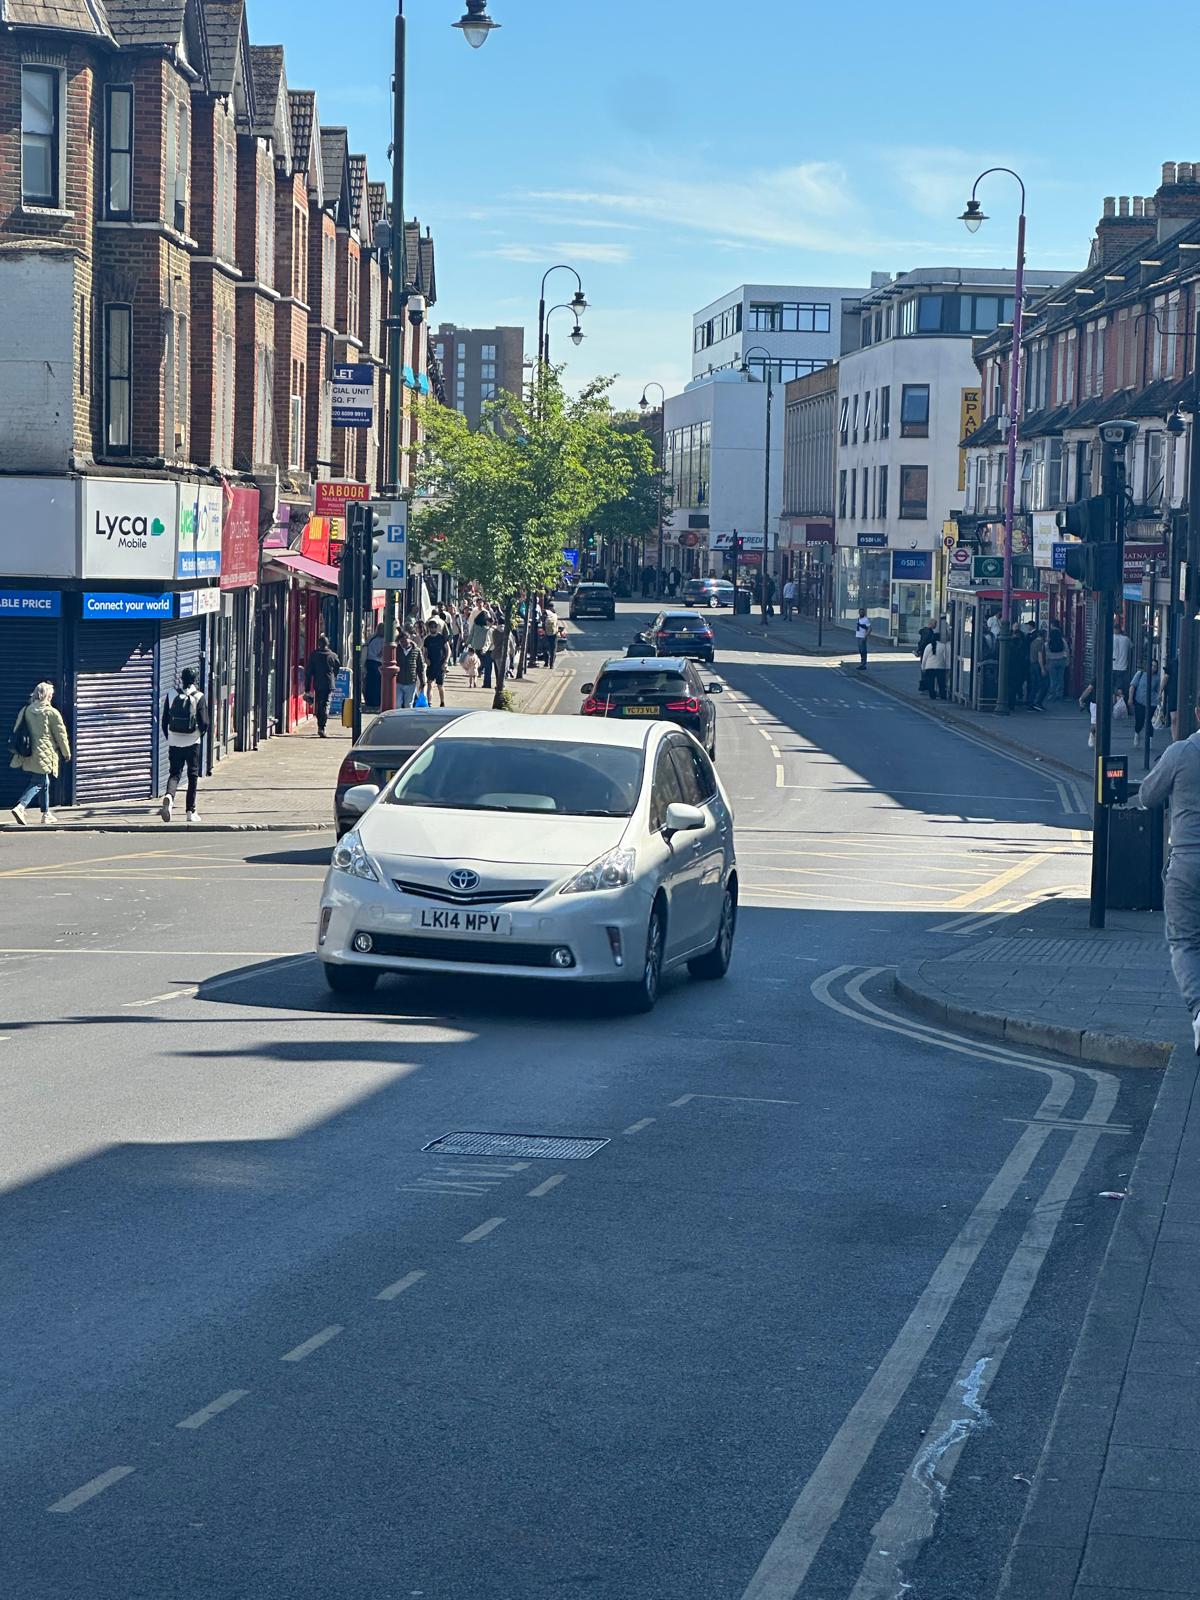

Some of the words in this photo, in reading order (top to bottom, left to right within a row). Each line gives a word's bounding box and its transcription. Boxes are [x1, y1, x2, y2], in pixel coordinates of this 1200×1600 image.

[333, 369, 354, 378] LET
[321, 484, 365, 498] SABOOR
[95, 510, 147, 540] Lyca
[118, 538, 147, 549] Mobile
[22, 599, 52, 609] PRICE
[87, 599, 123, 610] Connect
[125, 601, 144, 613] your
[145, 599, 170, 610] world
[420, 909, 461, 929] LK14
[465, 913, 500, 932] MPV
